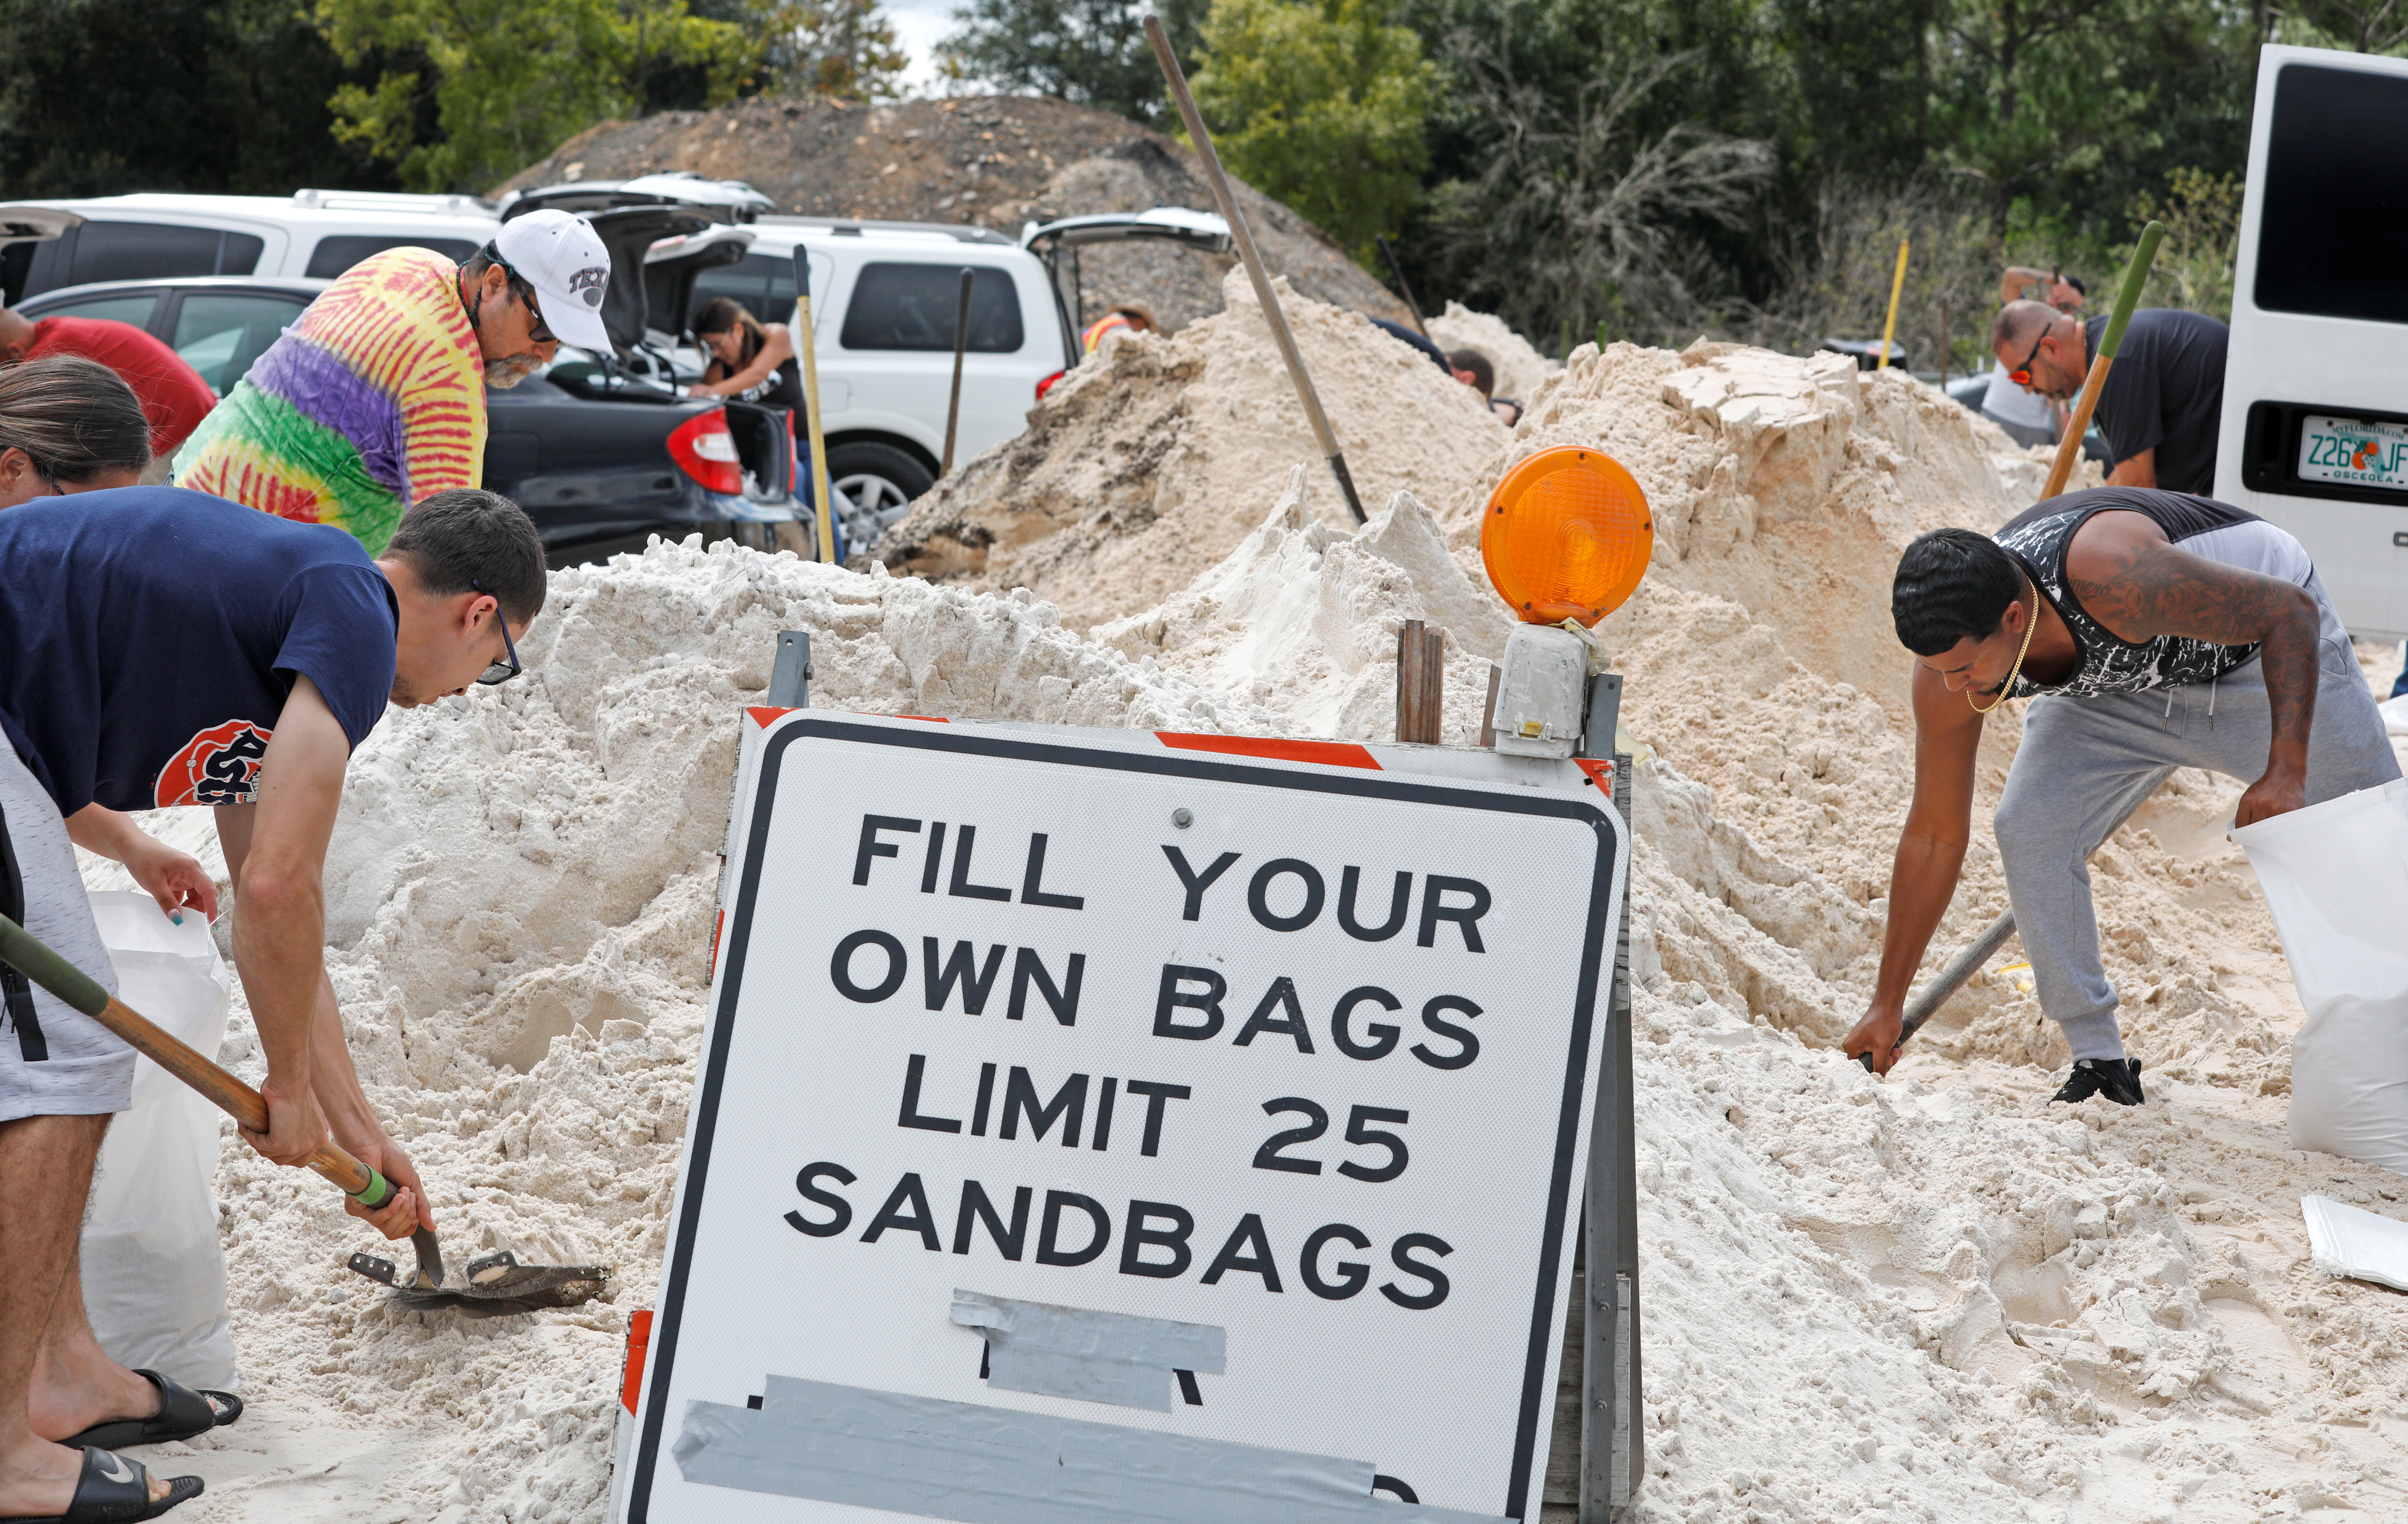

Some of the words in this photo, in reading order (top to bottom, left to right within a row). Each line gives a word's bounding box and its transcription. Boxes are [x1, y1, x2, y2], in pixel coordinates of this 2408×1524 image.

[2308, 434, 2351, 467] Z26
[2334, 470, 2393, 483] OSCEOLA
[853, 814, 1084, 910] FILL
[1161, 845, 1491, 953] YOUR
[831, 930, 1085, 1026] OWN
[1153, 964, 1484, 1070] BAGS
[898, 1054, 1191, 1157] LIMIT
[1253, 1097, 1409, 1182] 25
[783, 1162, 1454, 1310] SANDBAGS
